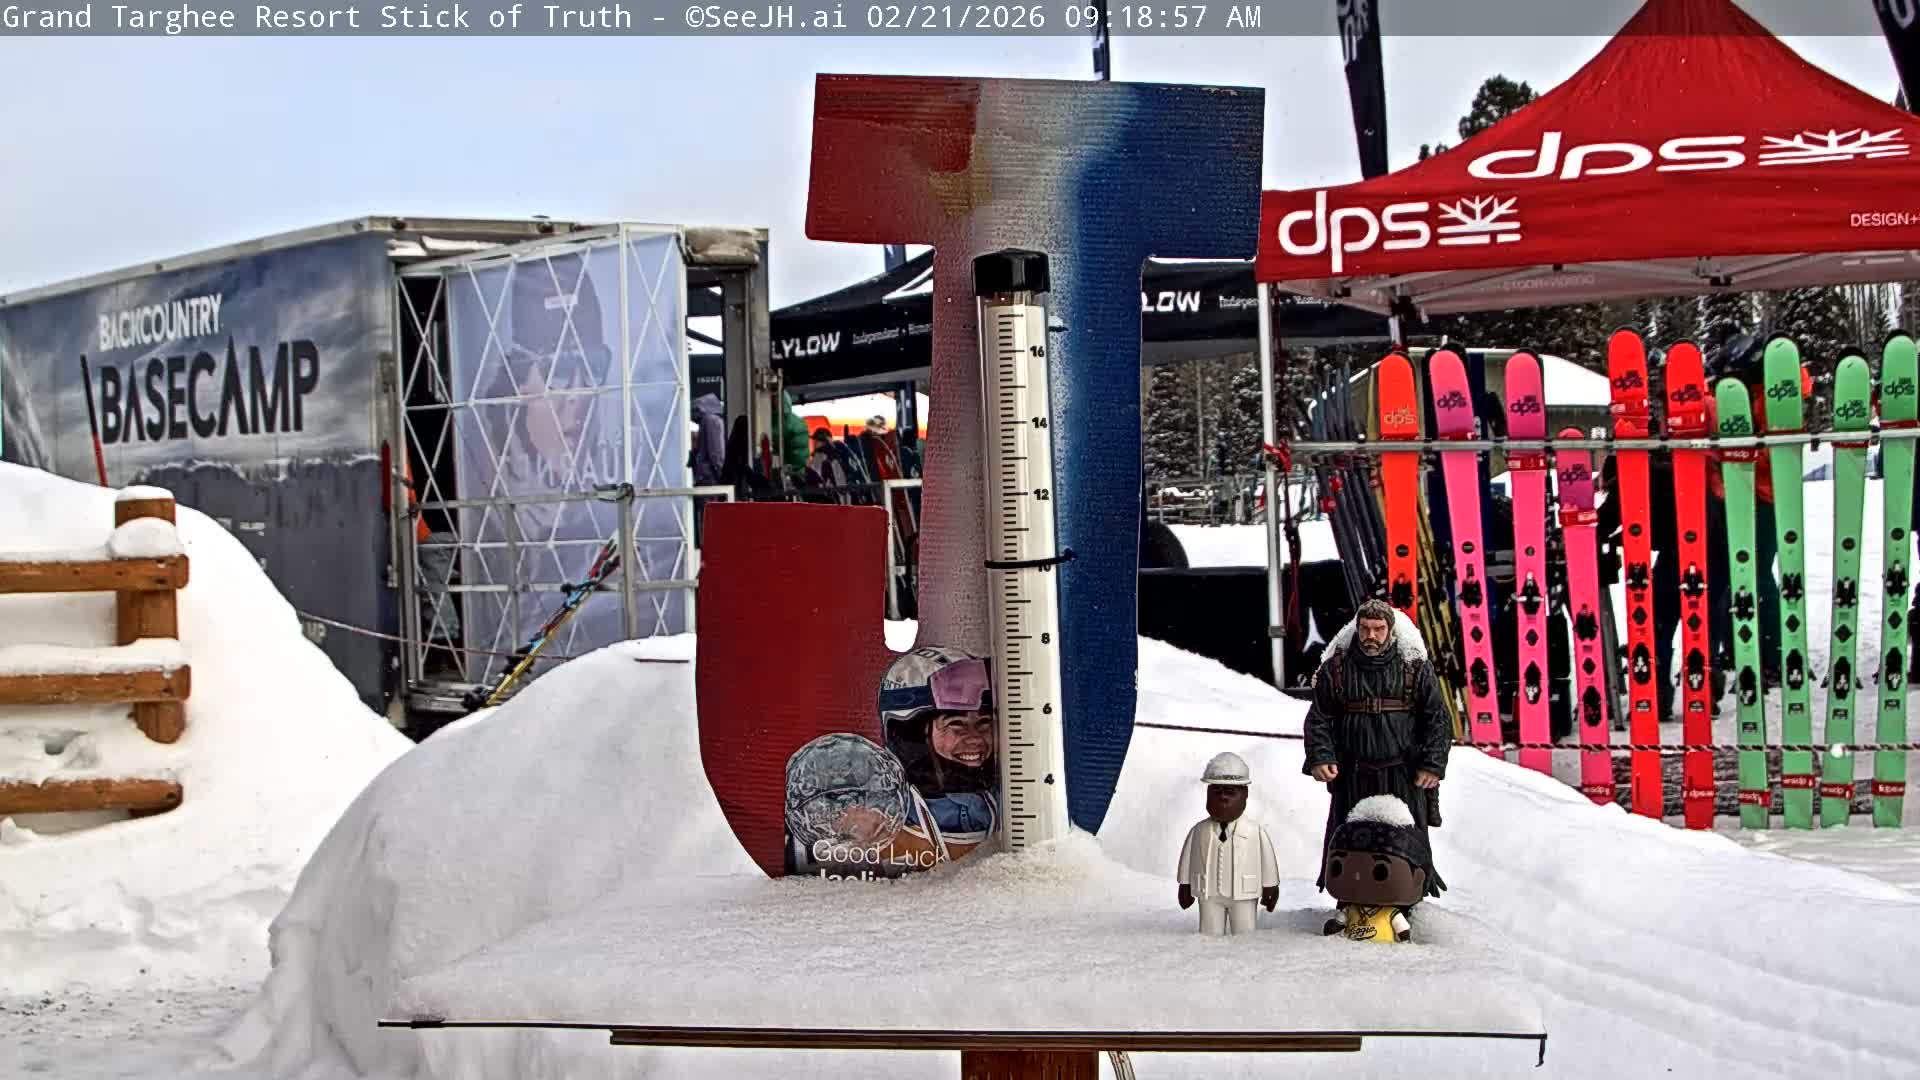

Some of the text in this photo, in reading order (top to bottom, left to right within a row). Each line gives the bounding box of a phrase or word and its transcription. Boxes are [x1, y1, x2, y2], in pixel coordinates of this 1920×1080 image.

[1468, 131, 1745, 180] dps
[1278, 191, 1431, 273] dps
[98, 292, 222, 351] BACKCOUNTRY
[1030, 345, 1045, 358] 16
[98, 334, 320, 444] BASECAMP
[1767, 383, 1799, 401] dps
[1884, 382, 1915, 399] dps
[1836, 403, 1867, 421] dps
[1032, 416, 1048, 429] 14
[1033, 488, 1050, 500] 12
[1041, 632, 1050, 644] 8
[1042, 703, 1053, 714] 6
[1044, 773, 1055, 785] 4
[812, 839, 947, 867] Good Luck
